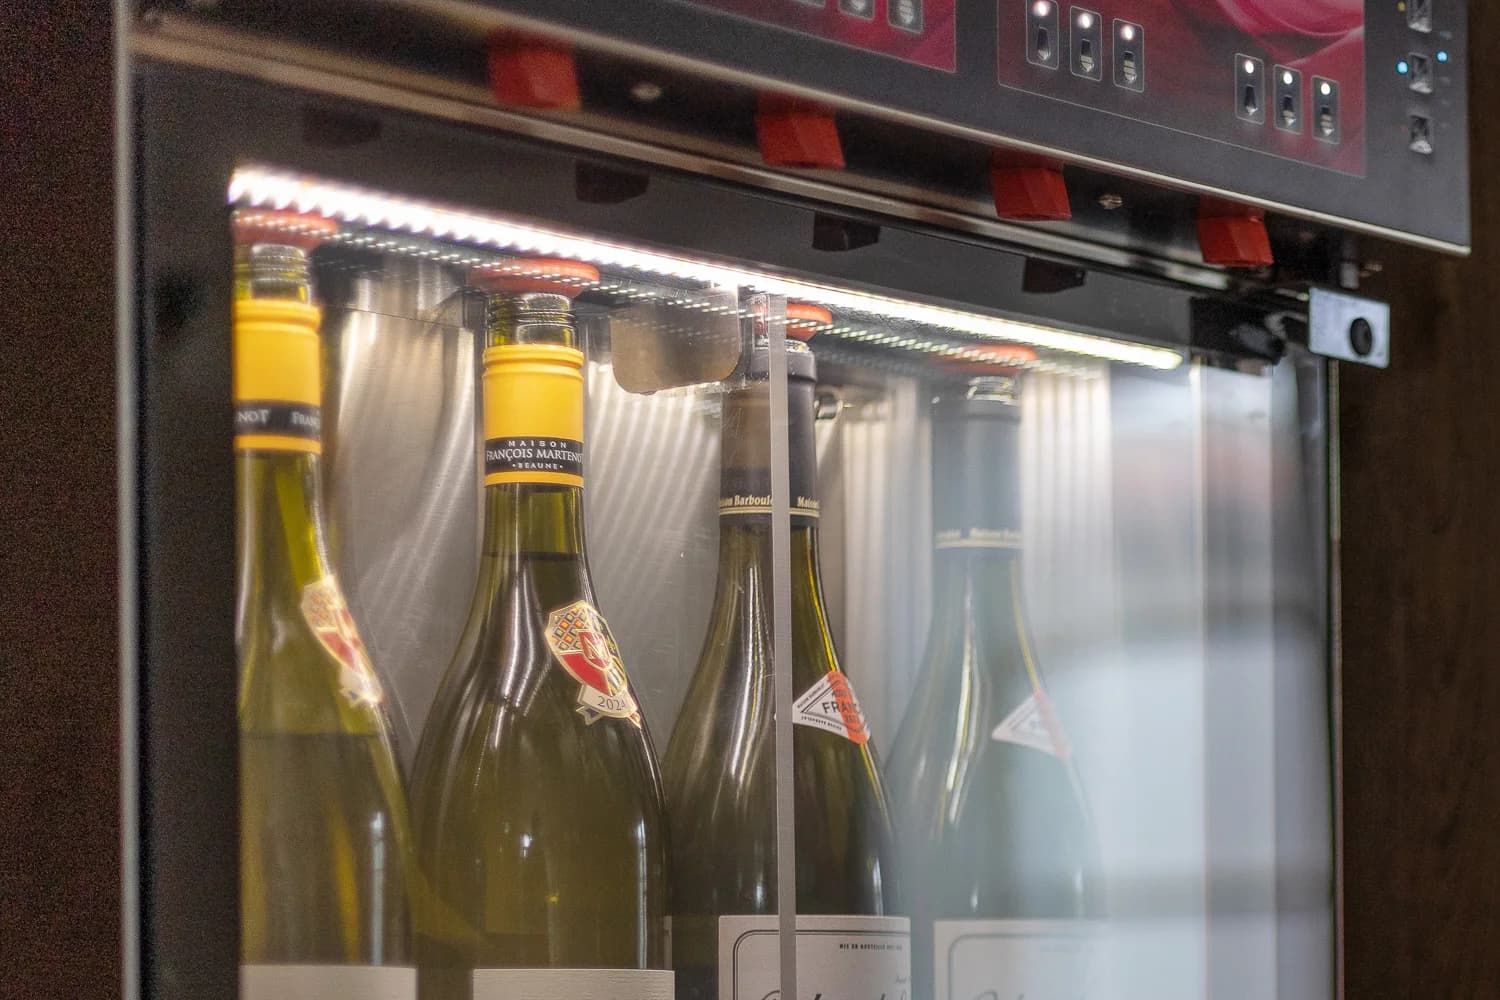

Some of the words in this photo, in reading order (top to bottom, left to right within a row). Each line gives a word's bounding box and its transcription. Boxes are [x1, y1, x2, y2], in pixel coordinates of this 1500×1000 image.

[508, 440, 567, 449] MAISON
[486, 448, 533, 462] FRANÇOIS
[536, 448, 583, 464] MARTENO
[518, 462, 558, 470] BEAUNE
[734, 494, 773, 506] Barboul
